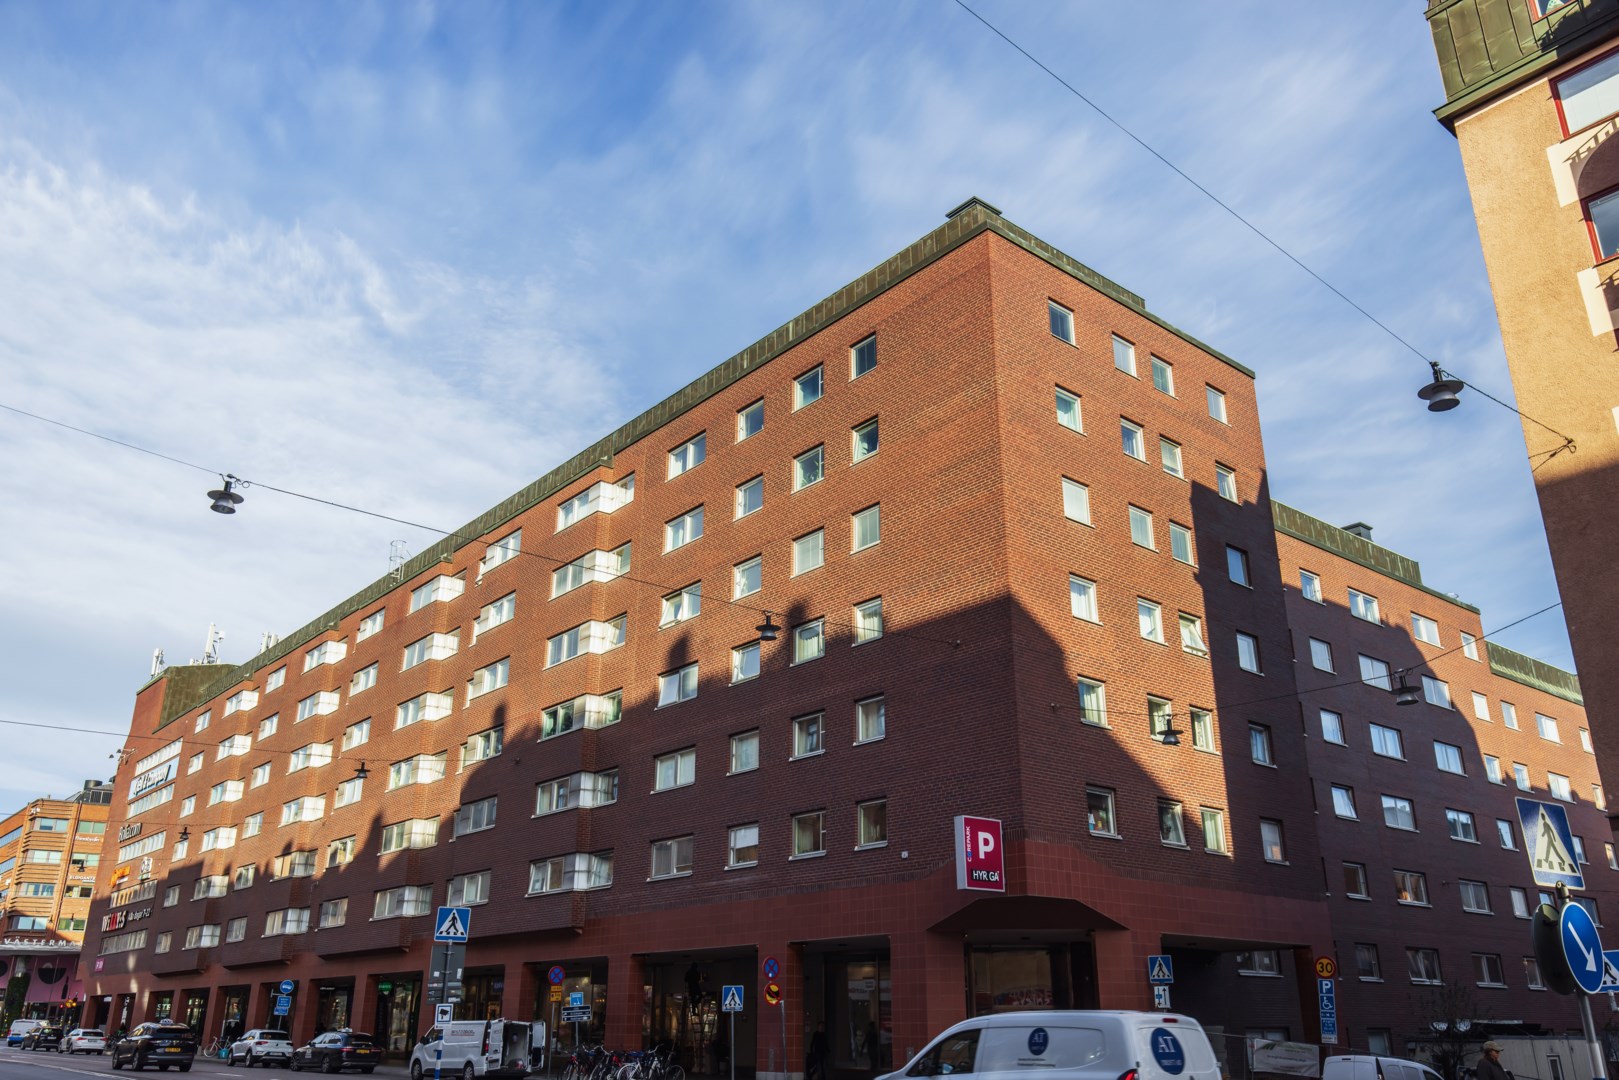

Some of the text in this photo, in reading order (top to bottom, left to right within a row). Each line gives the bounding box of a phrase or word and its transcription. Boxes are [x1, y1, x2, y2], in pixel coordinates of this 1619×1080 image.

[977, 831, 995, 860] P
[972, 869, 989, 881] HYR
[1318, 961, 1333, 974] 30
[1322, 980, 1332, 994] P
[1157, 1035, 1176, 1053] AT
